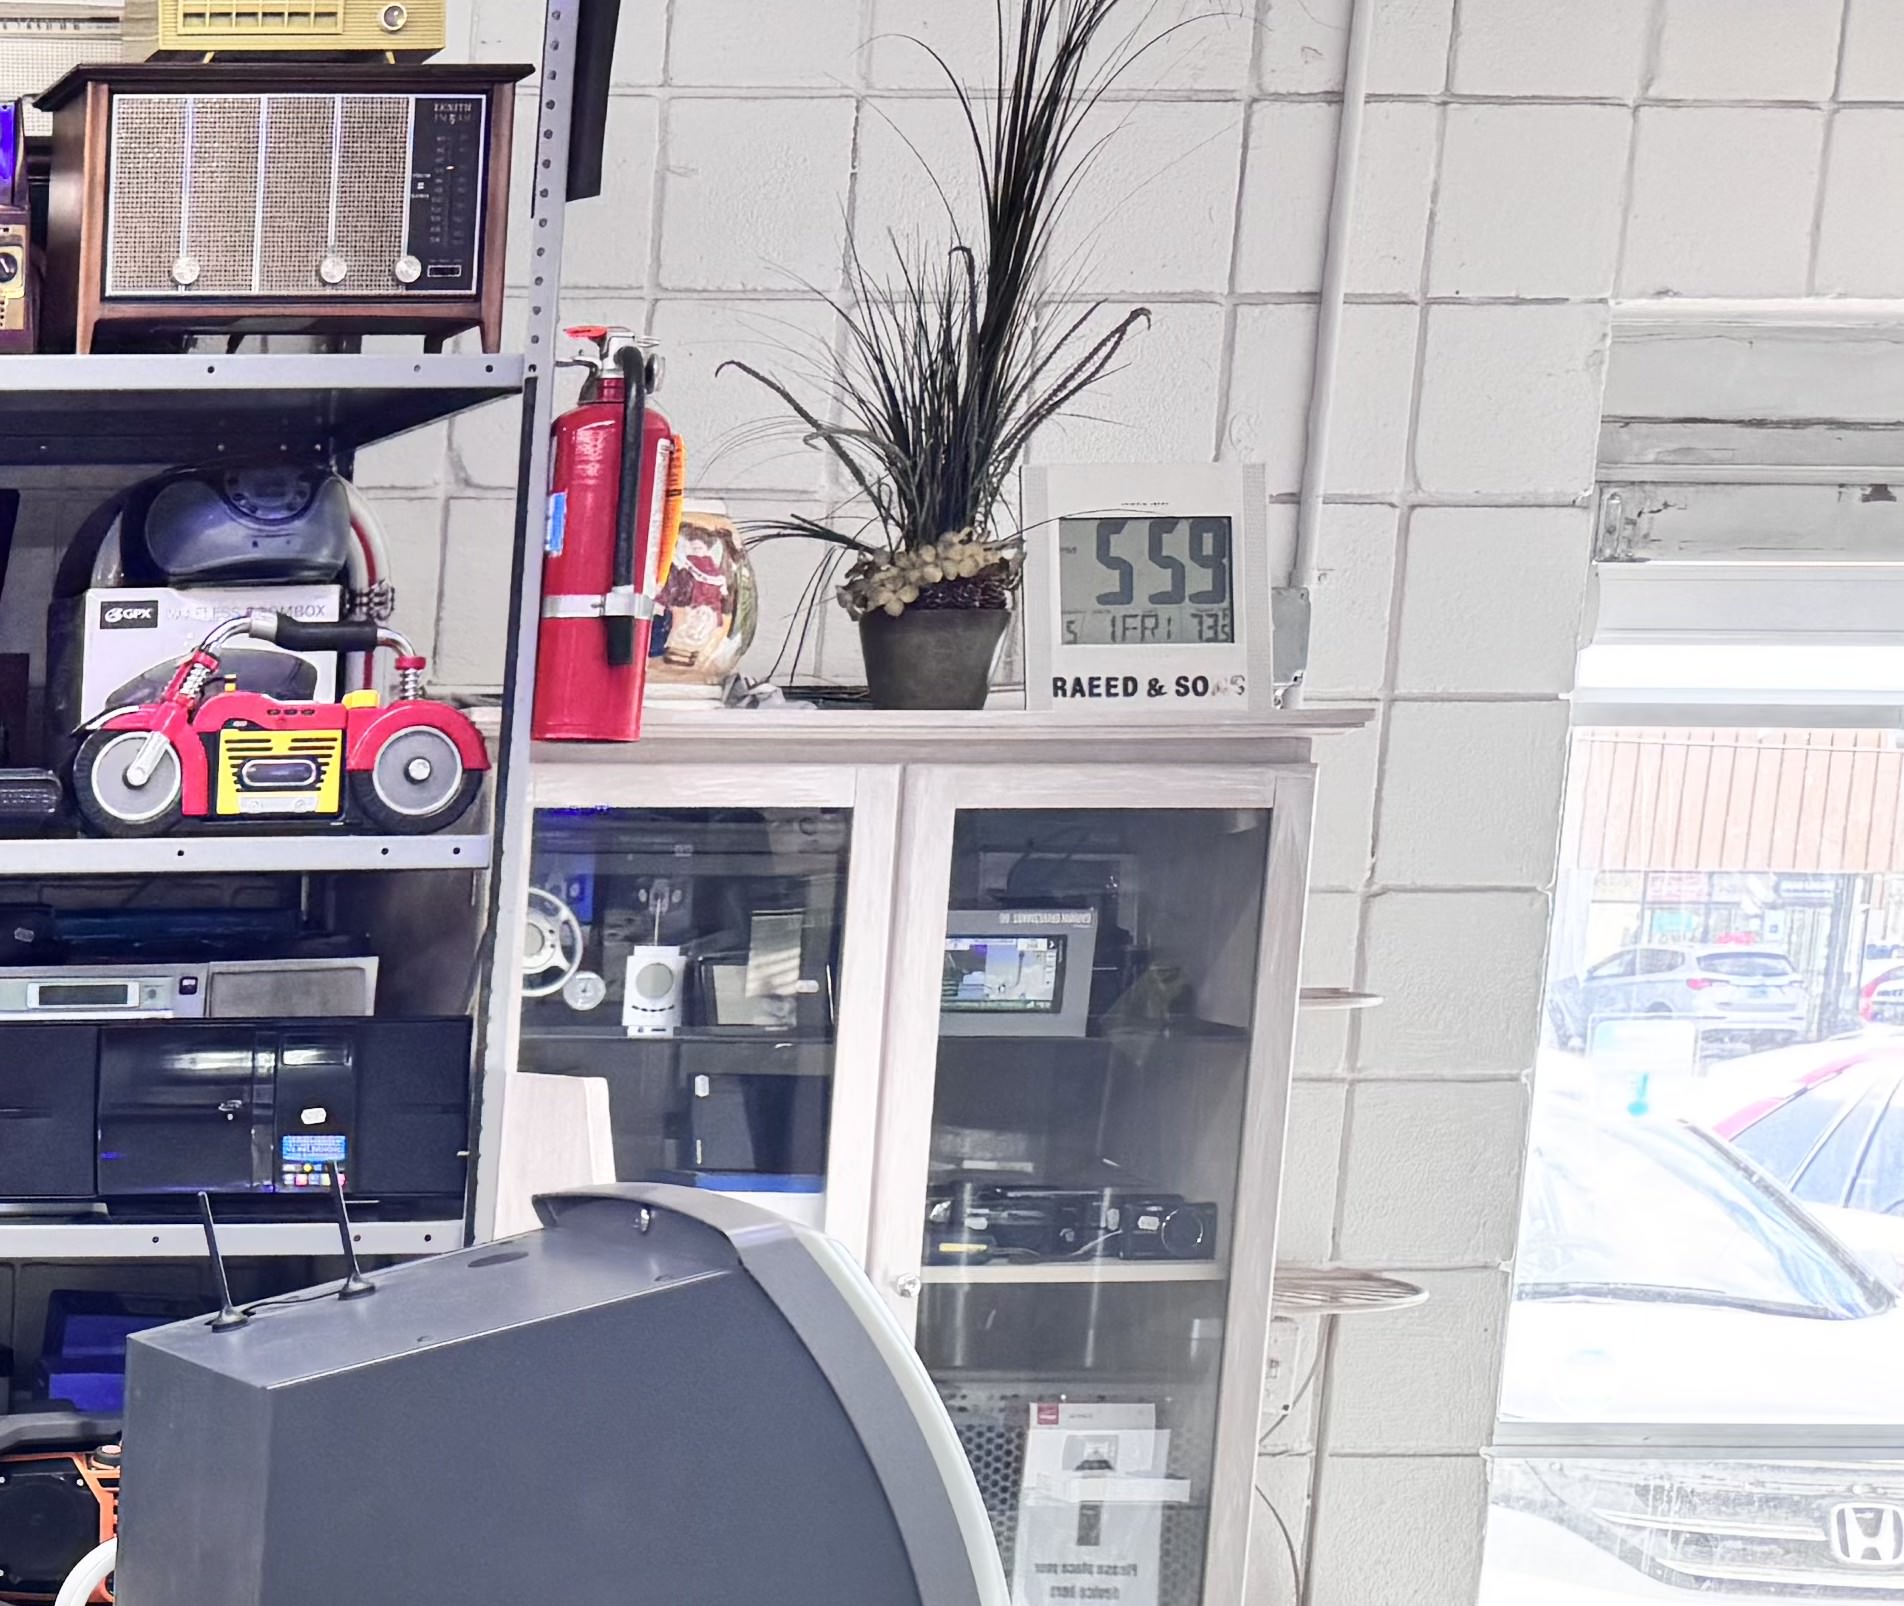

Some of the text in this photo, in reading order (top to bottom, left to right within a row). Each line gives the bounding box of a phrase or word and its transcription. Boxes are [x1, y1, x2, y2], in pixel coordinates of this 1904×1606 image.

[122, 607, 152, 620] GPX
[1052, 676, 1138, 699] RAEED
[1146, 677, 1168, 698] &
